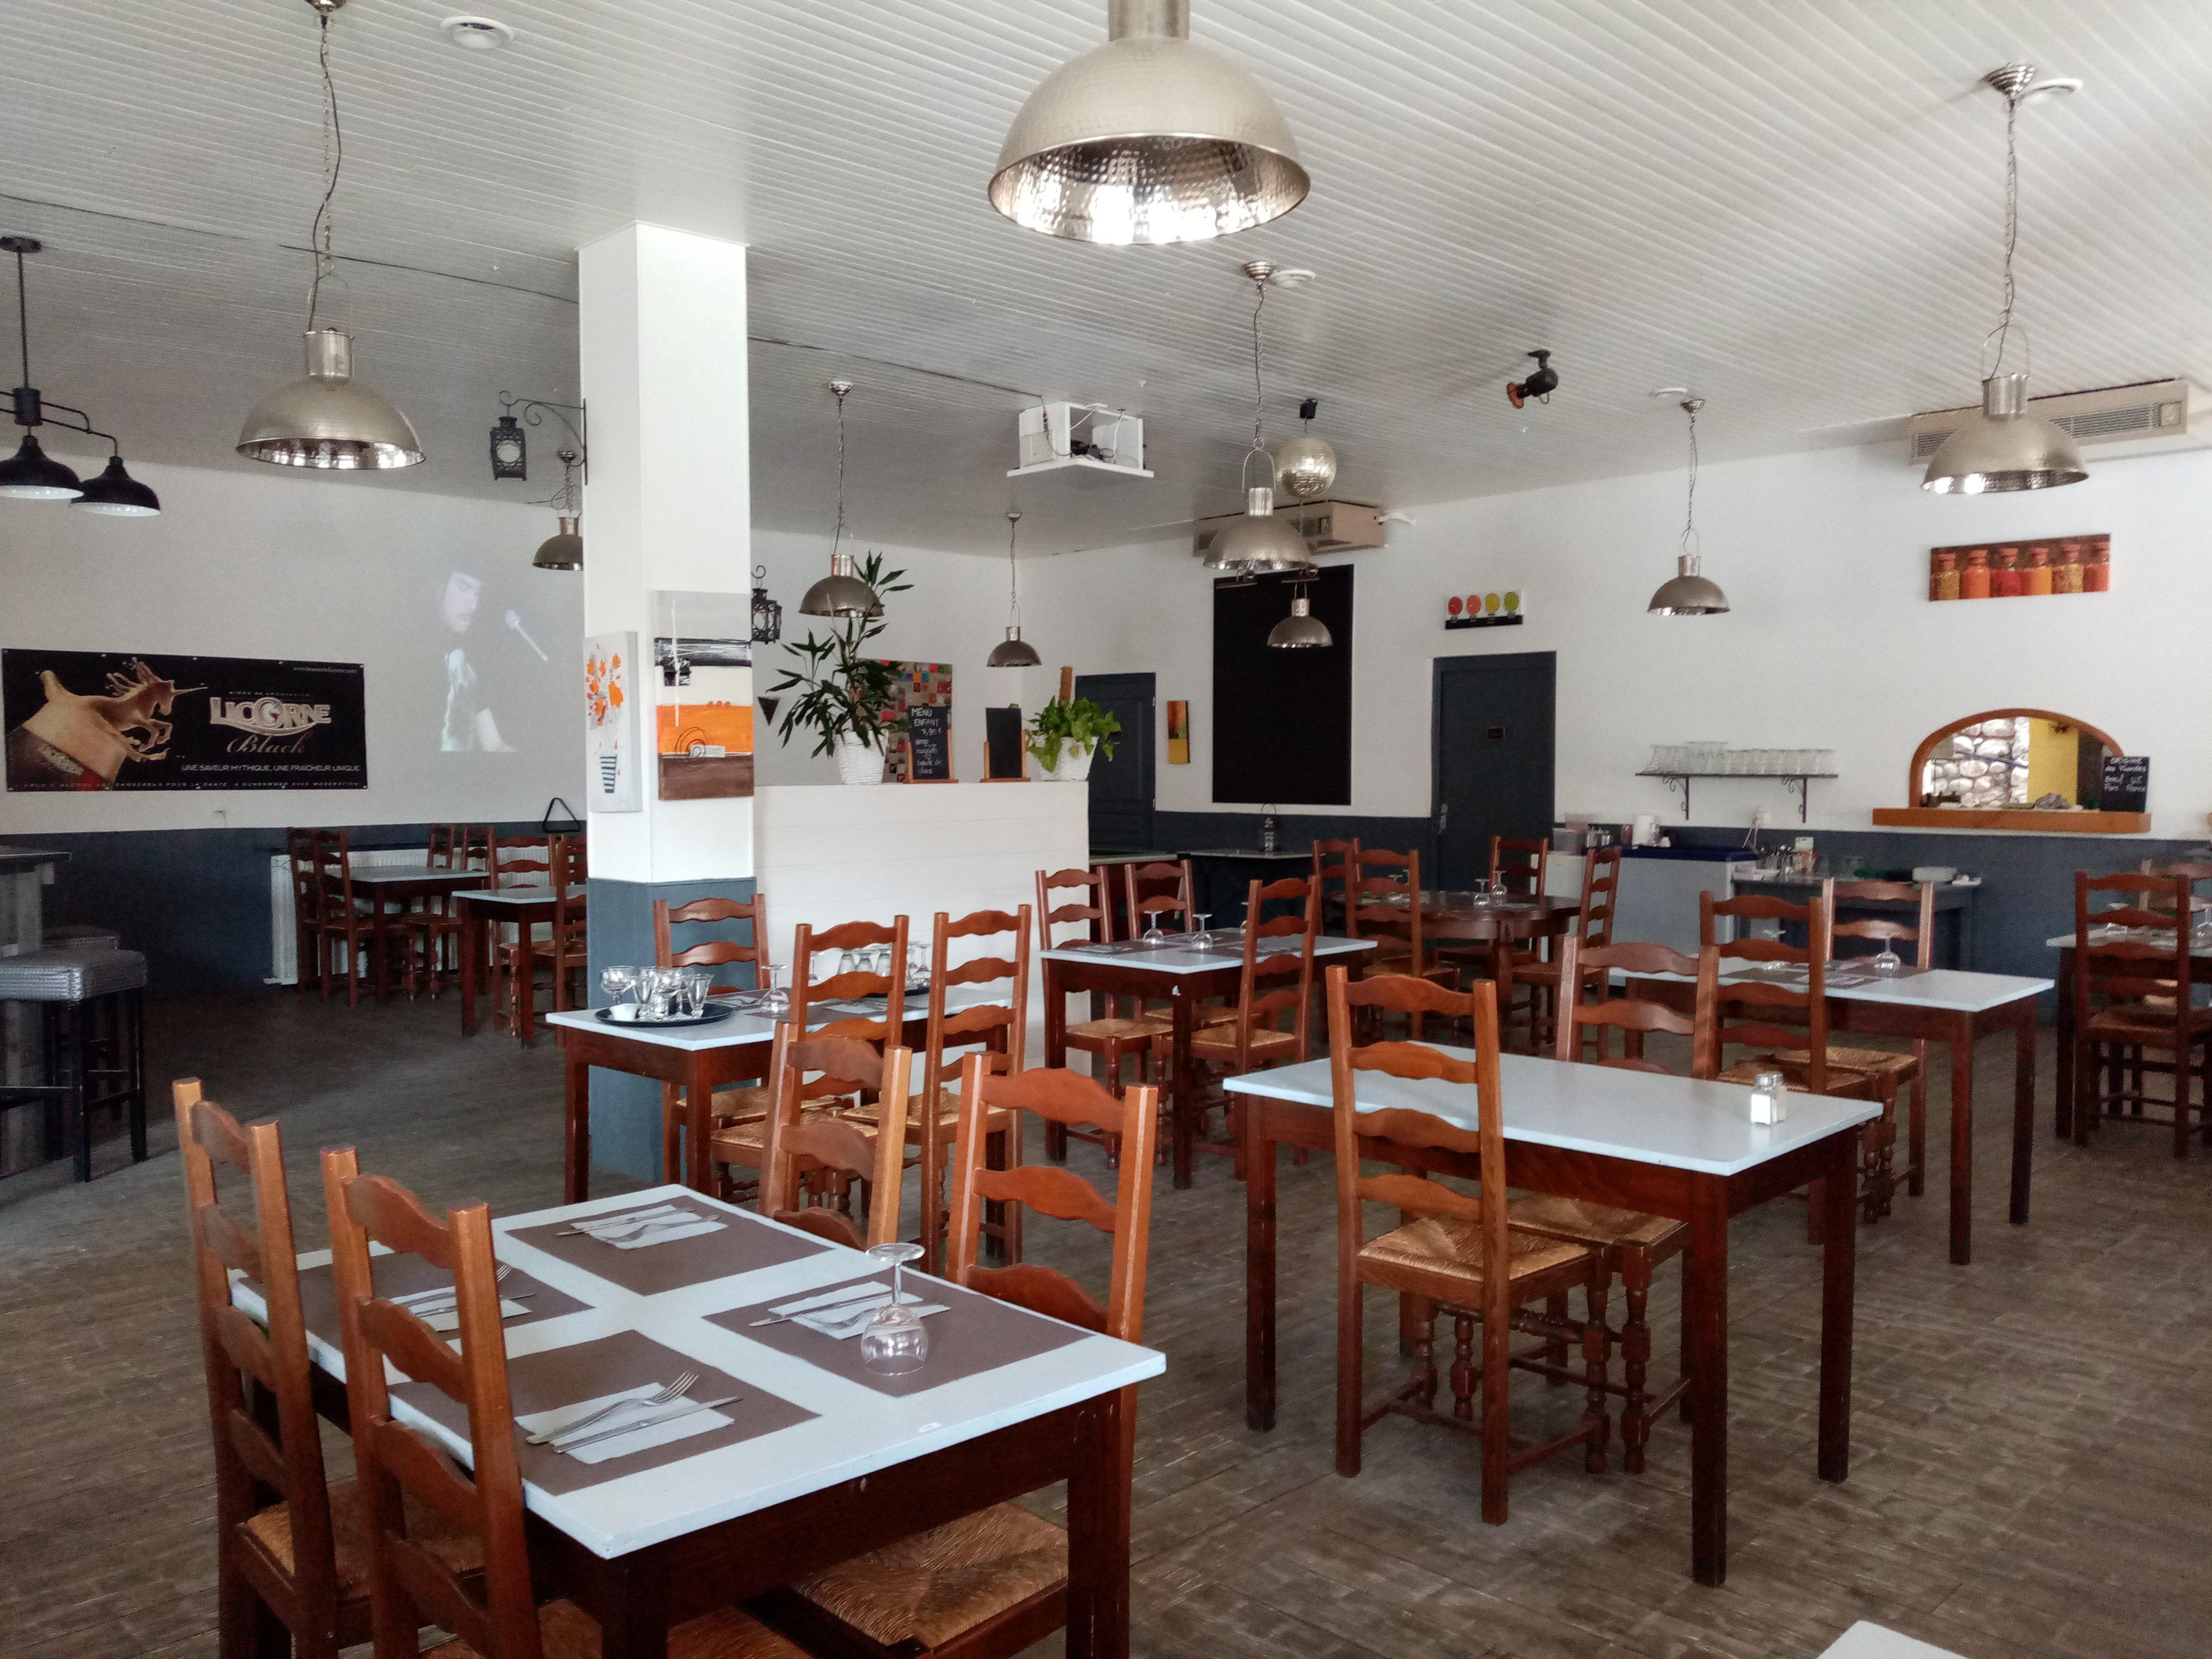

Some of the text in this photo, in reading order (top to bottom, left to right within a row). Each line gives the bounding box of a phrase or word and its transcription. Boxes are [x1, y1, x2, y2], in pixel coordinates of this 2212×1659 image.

[210, 697, 332, 732] LICORNE
[911, 707, 933, 717] MENU
[227, 732, 313, 753] Black
